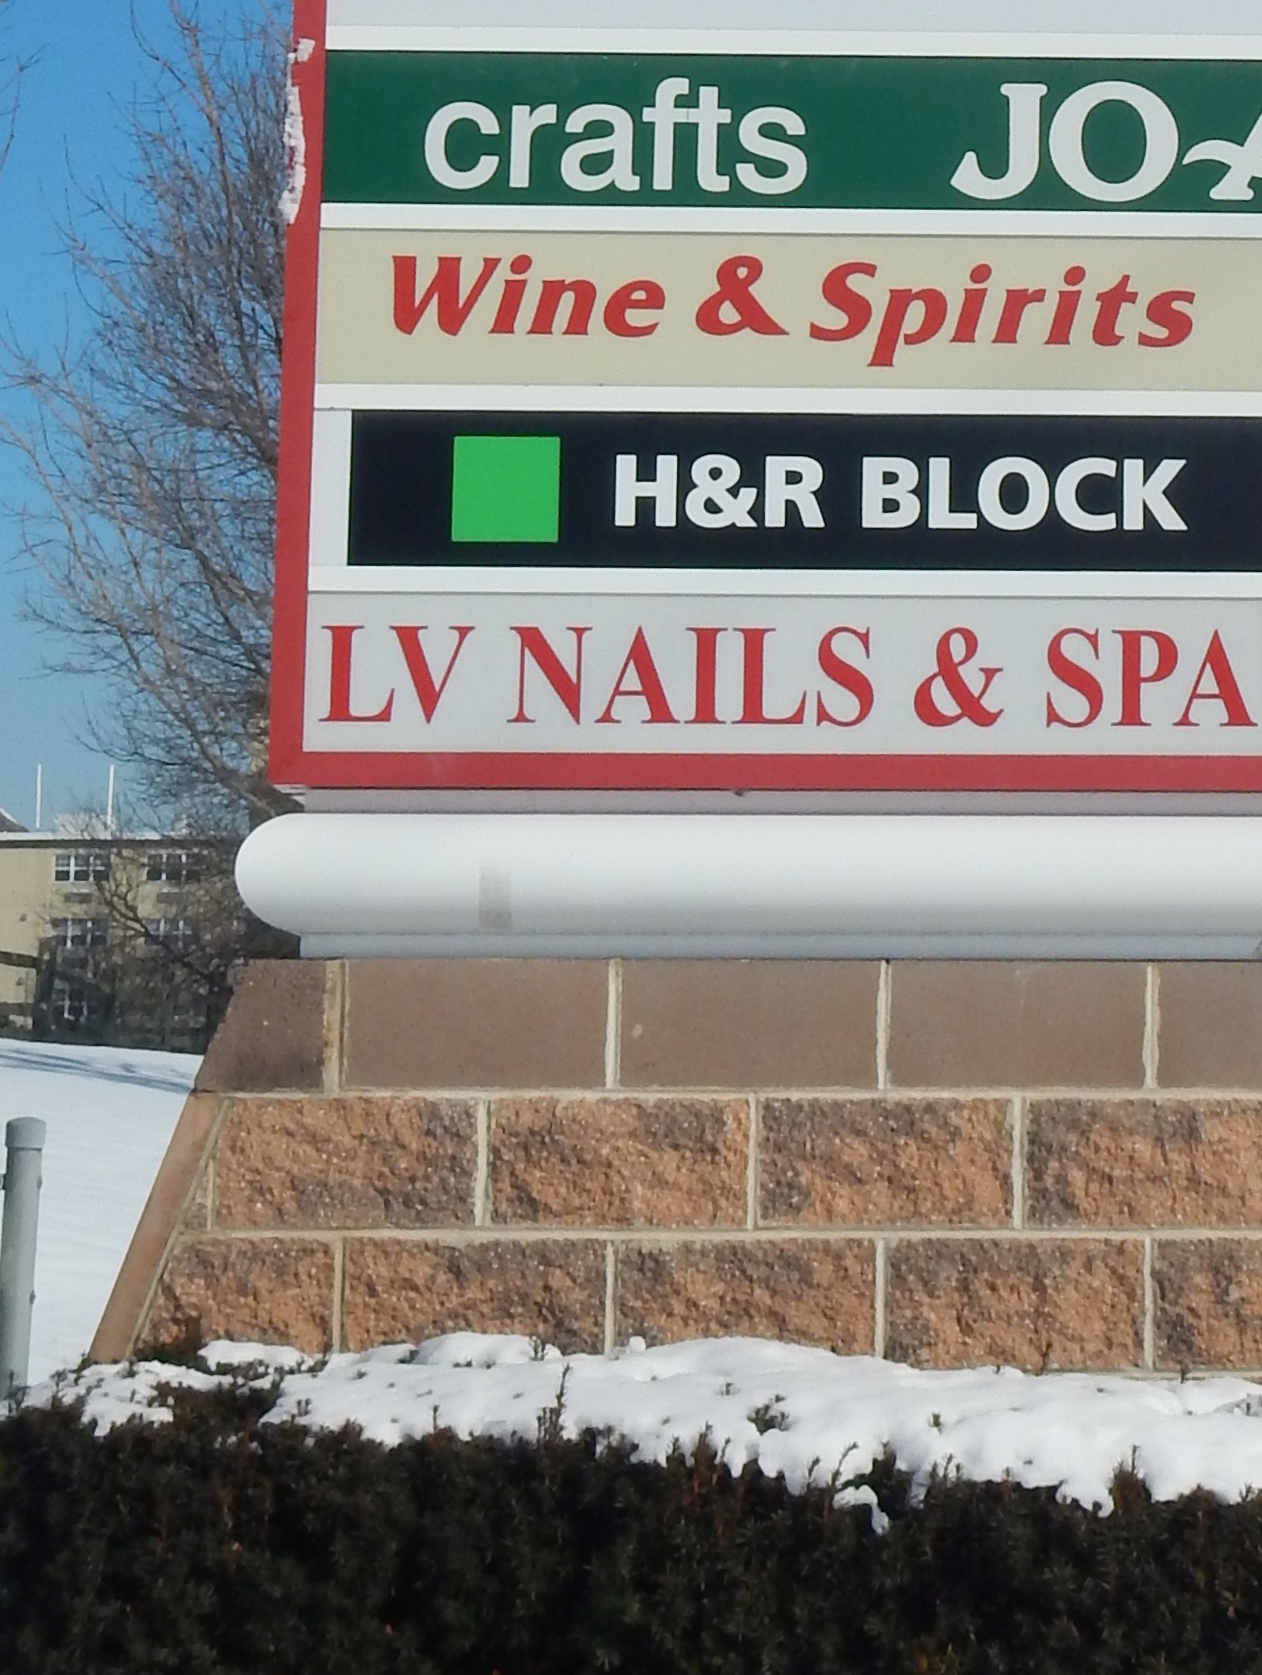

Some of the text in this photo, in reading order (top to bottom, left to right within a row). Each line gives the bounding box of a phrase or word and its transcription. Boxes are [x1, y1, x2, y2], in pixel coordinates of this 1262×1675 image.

[423, 76, 809, 195] crafts
[391, 252, 1197, 368] Wine & Spirits
[612, 452, 1189, 532] H&R BLOCK
[318, 624, 1260, 729] LV NAILS & SPA
